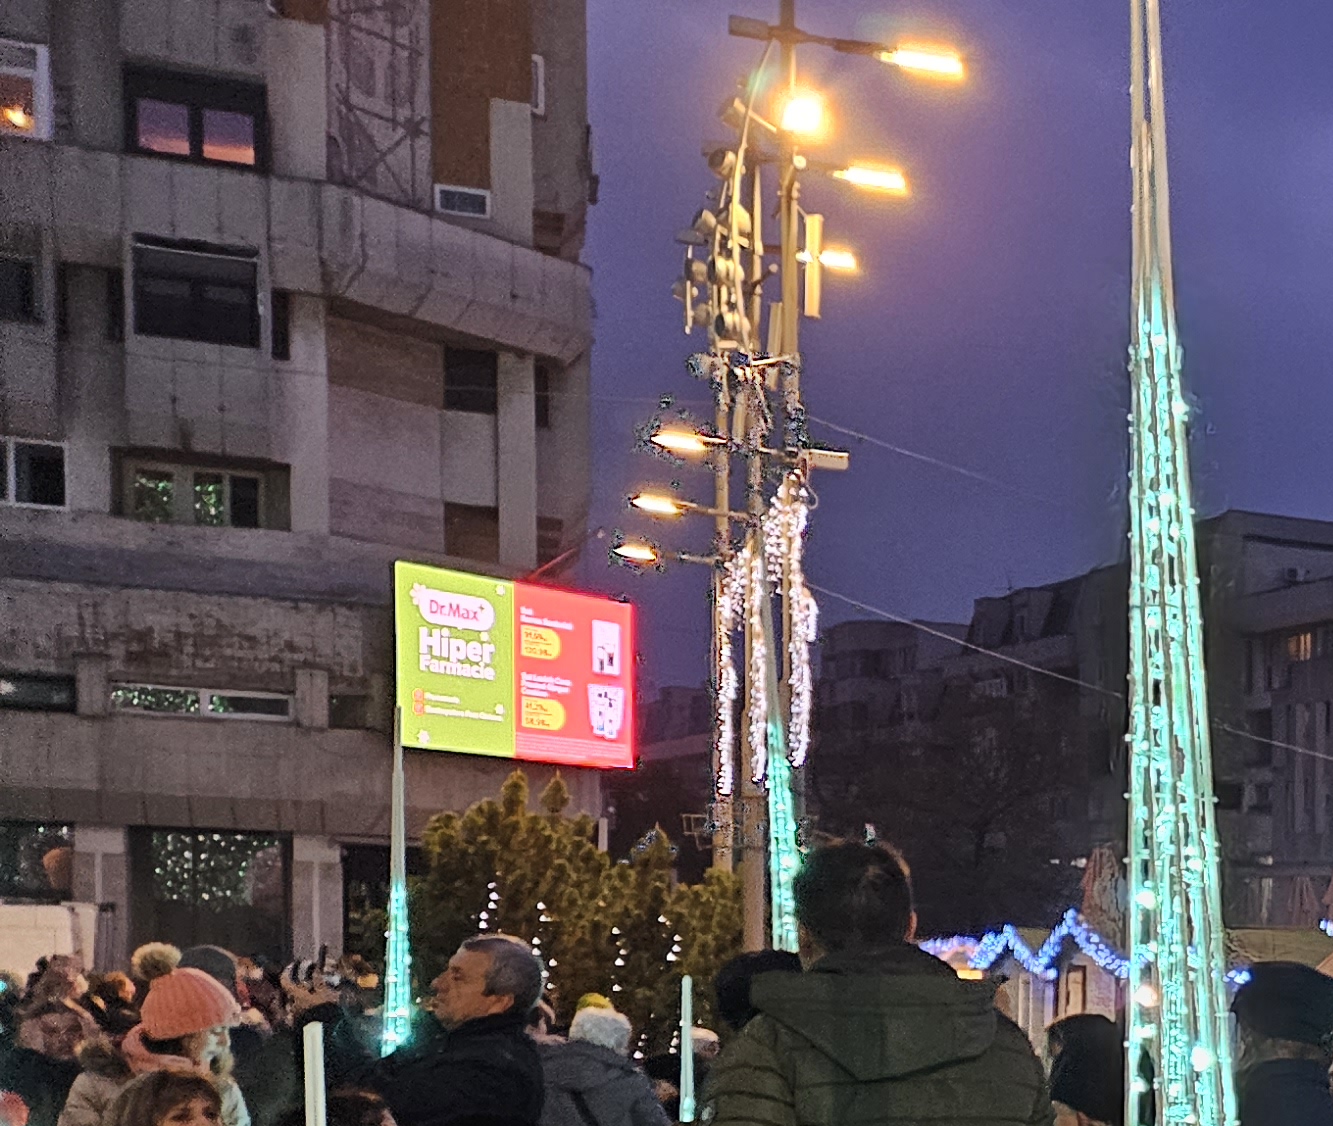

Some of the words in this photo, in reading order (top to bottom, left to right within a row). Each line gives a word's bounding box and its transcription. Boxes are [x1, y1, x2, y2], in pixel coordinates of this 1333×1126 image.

[428, 598, 480, 622] Dr.Max
[418, 626, 496, 665] Hiper
[418, 653, 497, 682] Farmacie
